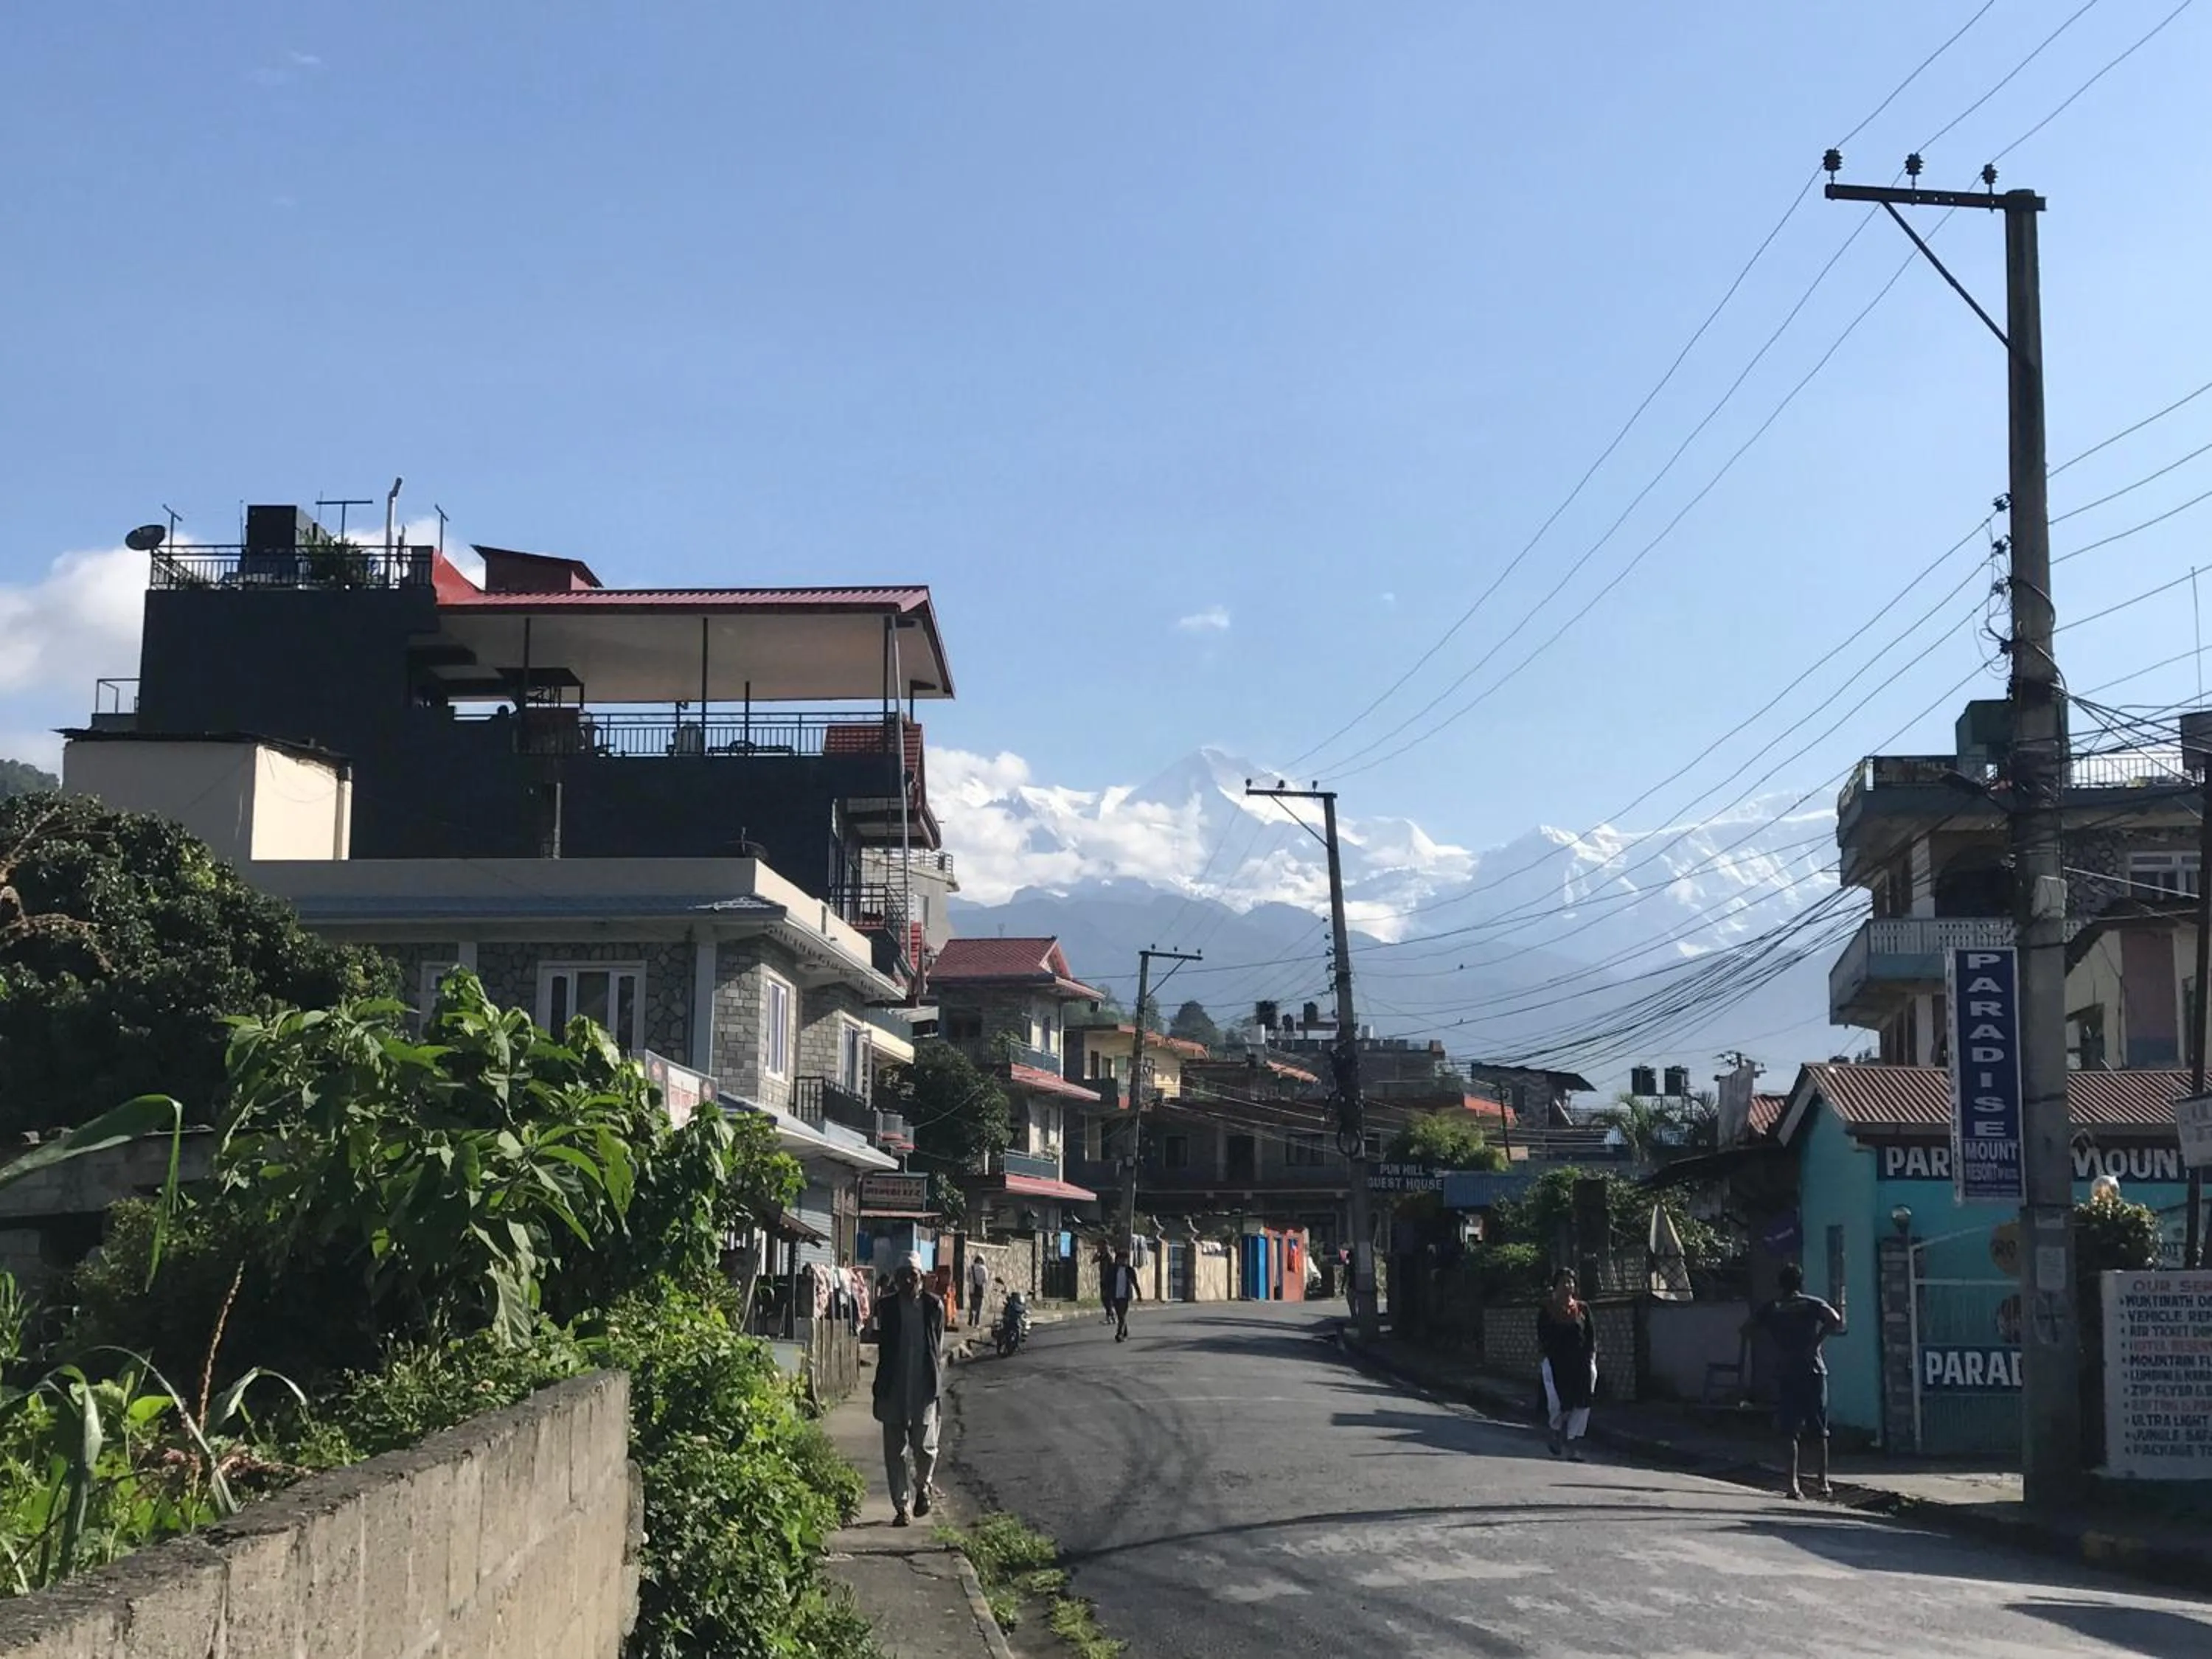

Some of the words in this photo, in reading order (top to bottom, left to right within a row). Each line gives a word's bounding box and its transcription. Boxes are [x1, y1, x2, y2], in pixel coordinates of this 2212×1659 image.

[1966, 953, 2006, 1136] PARADISE
[1964, 1142, 2017, 1161] MOUNT
[2070, 1147, 2188, 1179] MOUN
[1367, 1177, 1402, 1190] GUEST
[1406, 1178, 1443, 1190] HOUSE
[2133, 1279, 2171, 1293] OUR
[2128, 1310, 2183, 1322] VEHICLE
[2129, 1354, 2195, 1367] MOUNTAIN
[2132, 1414, 2171, 1427] ULTRA
[2174, 1414, 2209, 1427] LIGHT
[2132, 1429, 2180, 1441] JUNGLE
[2132, 1444, 2195, 1457] PACKAGE
